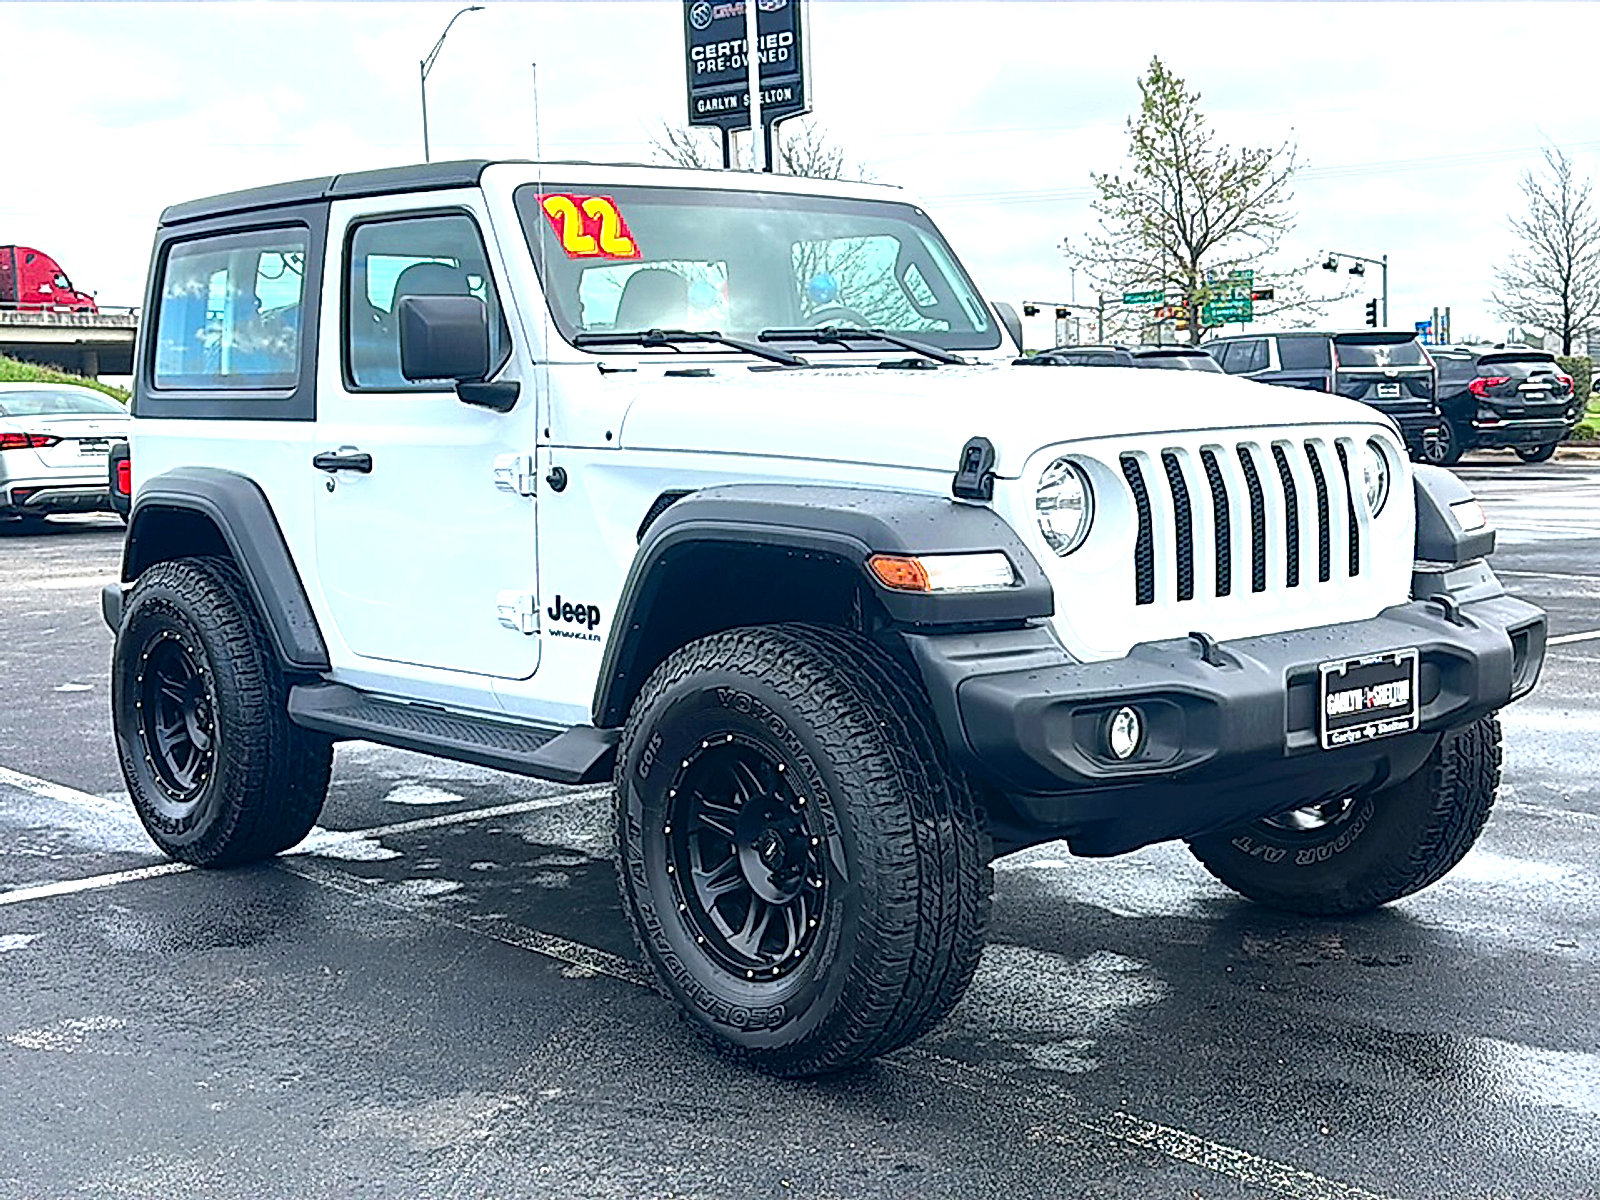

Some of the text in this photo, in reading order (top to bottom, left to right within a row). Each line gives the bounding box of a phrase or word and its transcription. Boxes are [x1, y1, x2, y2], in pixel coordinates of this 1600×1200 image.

[691, 31, 793, 60] CERTIIED
[697, 88, 792, 113] GARLYN SELTON
[542, 195, 634, 256] 22
[547, 594, 600, 630] Jeep
